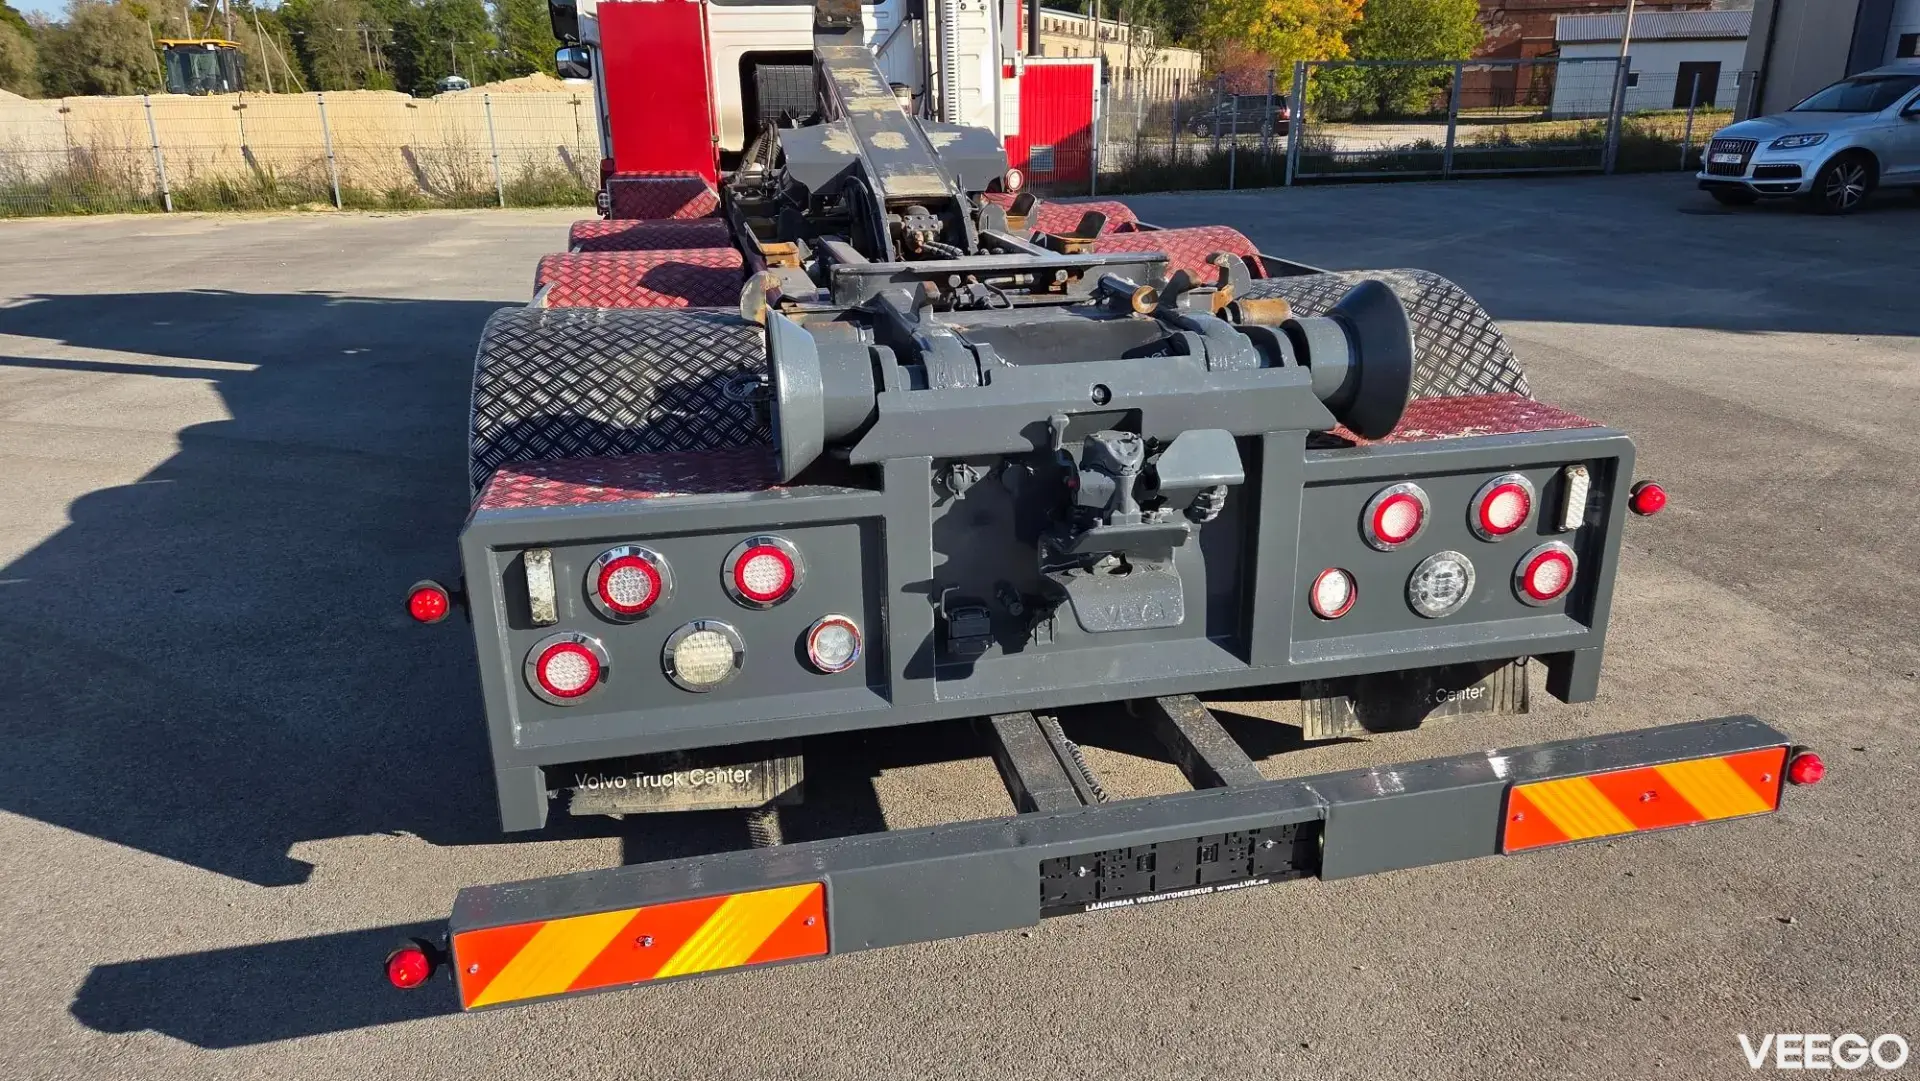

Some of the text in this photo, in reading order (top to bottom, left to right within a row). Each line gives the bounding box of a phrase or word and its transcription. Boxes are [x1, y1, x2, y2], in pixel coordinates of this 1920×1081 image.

[1435, 687, 1486, 703] Center
[575, 767, 752, 790] Volvo Truck Center
[1136, 886, 1213, 903] VEOAUTOKESKUS
[1216, 878, 1270, 892] www.LVK.ee
